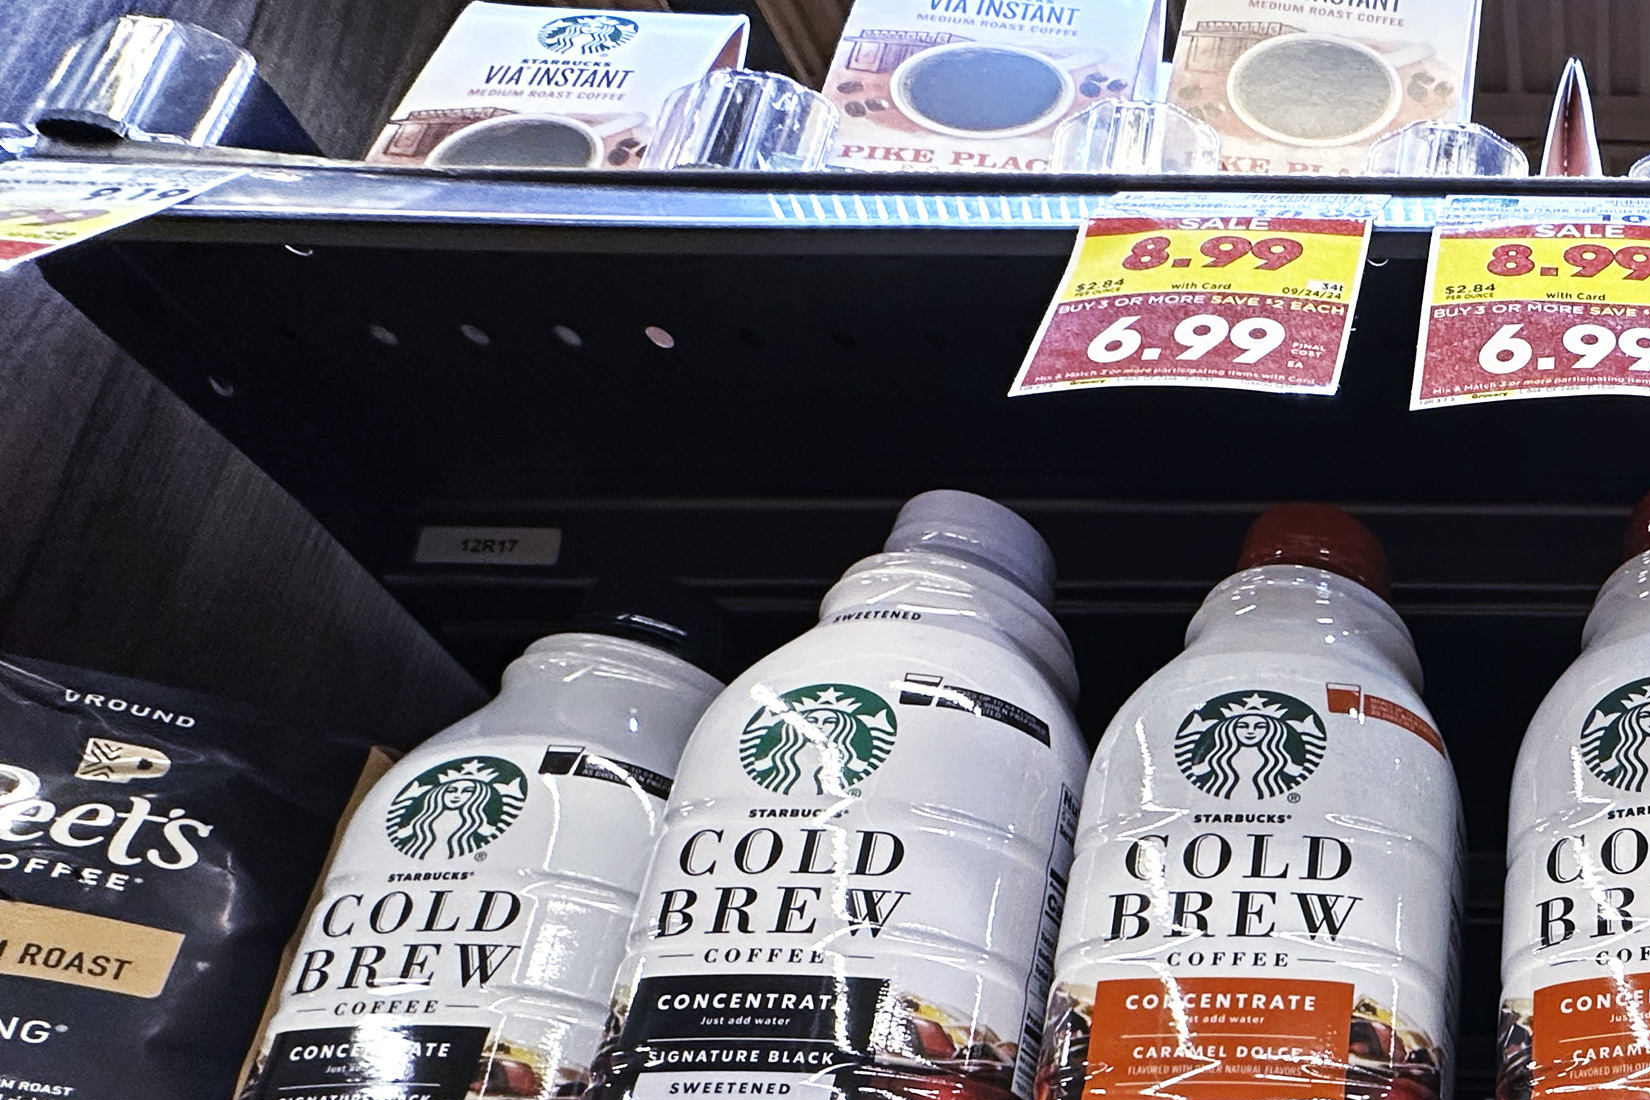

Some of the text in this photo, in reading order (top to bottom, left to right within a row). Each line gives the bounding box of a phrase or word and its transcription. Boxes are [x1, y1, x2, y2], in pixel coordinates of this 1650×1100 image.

[930, 0, 1080, 26] VIA INSTANT
[1247, 1, 1405, 27] MEDIUM ROAST COFFEE
[916, 13, 1079, 37] MEDIUM ROAST COFFEE
[521, 58, 612, 67] STARBUCKS
[484, 65, 635, 88] VIA INSTANT
[467, 89, 626, 100] MEDIUM ROAST COFFEE
[838, 144, 1049, 172] PIKE PLAC
[1177, 216, 1271, 230] SALE
[1535, 224, 1626, 239] SALE
[1121, 236, 1304, 271] 8.99
[1281, 286, 1342, 300] 09/24/24
[1445, 283, 1496, 295] $2.84
[1545, 291, 1606, 301] with Card
[1086, 314, 1286, 364] 6.99
[832, 608, 922, 624] SWEETENED
[678, 828, 906, 876] COLD
[1124, 832, 1354, 881] COLD
[0, 854, 130, 891] OFFEE
[322, 889, 523, 938] COLD
[654, 886, 912, 939] BREW
[1105, 891, 1364, 942] BREW
[17, 943, 134, 980] ROAST
[703, 948, 827, 964] COFFEE
[1166, 952, 1290, 968] COFFEE
[295, 943, 524, 996] BREW
[333, 999, 439, 1017] COFFEE
[657, 993, 847, 1011] CONCENTRAT
[1125, 993, 1317, 1011] CONCENTRATE
[647, 1048, 834, 1066] SIGNATURE BLACK
[1132, 1044, 1304, 1060] CARAMEL DOLCE
[668, 1082, 792, 1095] SWEETENED
